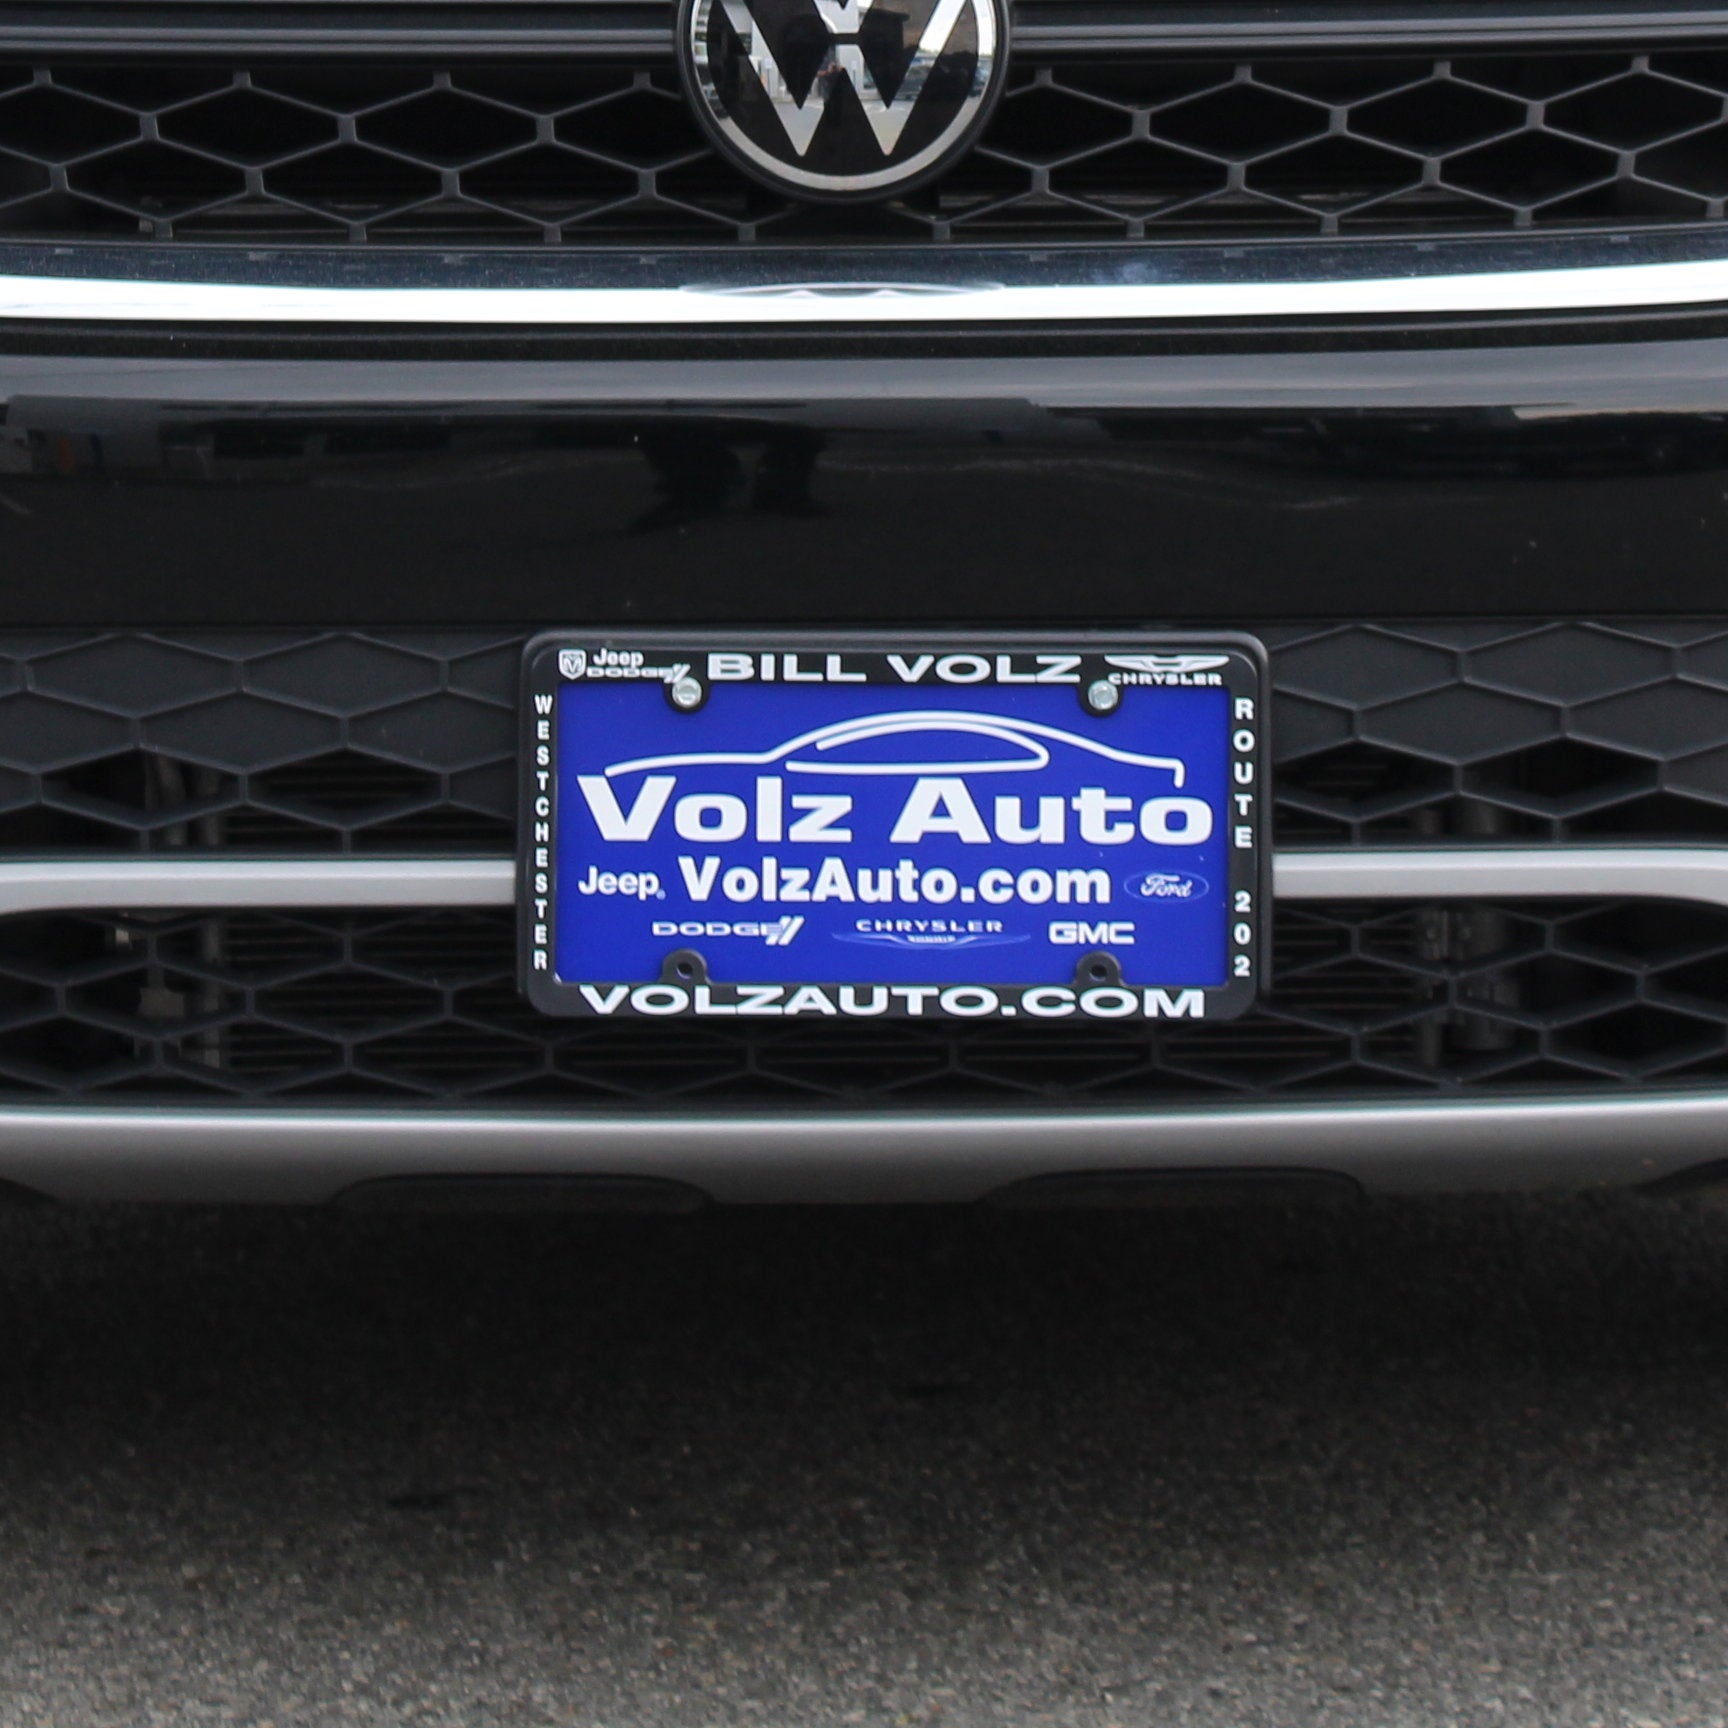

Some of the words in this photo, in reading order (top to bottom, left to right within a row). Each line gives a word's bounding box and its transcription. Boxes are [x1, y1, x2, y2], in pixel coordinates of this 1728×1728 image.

[592, 647, 644, 669] Jeep
[707, 652, 868, 683] BILL
[886, 654, 1082, 684] VOLZ
[1107, 672, 1223, 686] CHRYSLER
[1232, 697, 1256, 849] ROUTE
[576, 774, 853, 843] Volz
[888, 776, 1214, 846] Auto
[532, 694, 553, 971] WESTCHESTER
[676, 854, 1112, 904] VolzAuto.com
[1139, 873, 1193, 899] Ford
[651, 920, 784, 937] DODGE
[855, 918, 1004, 933] CHRYSLER
[1047, 920, 1136, 945] GMC
[1233, 889, 1252, 977] 202
[578, 983, 1206, 1018] VOLZAUTO.COM
